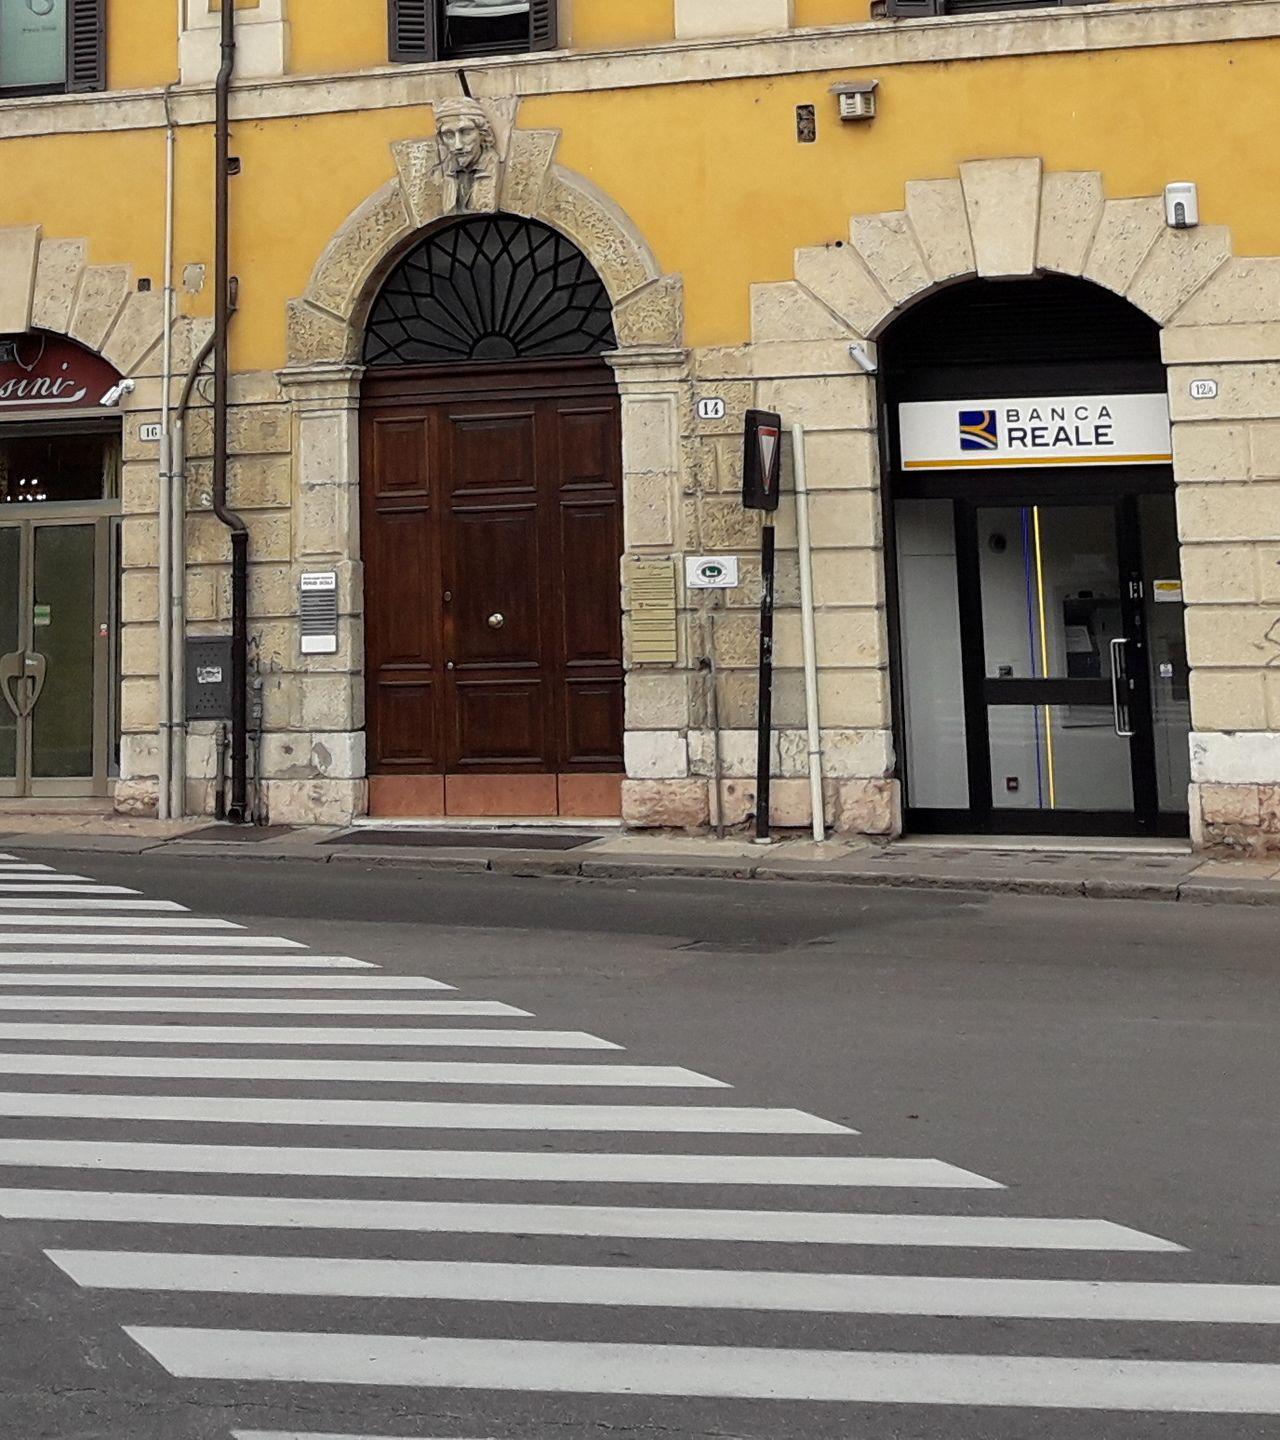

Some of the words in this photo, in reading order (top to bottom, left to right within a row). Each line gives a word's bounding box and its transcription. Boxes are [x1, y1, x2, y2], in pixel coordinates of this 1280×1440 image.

[703, 401, 720, 416] 14
[1006, 405, 1113, 423] BANCA
[146, 426, 158, 438] 16
[1007, 424, 1115, 449] REALE
